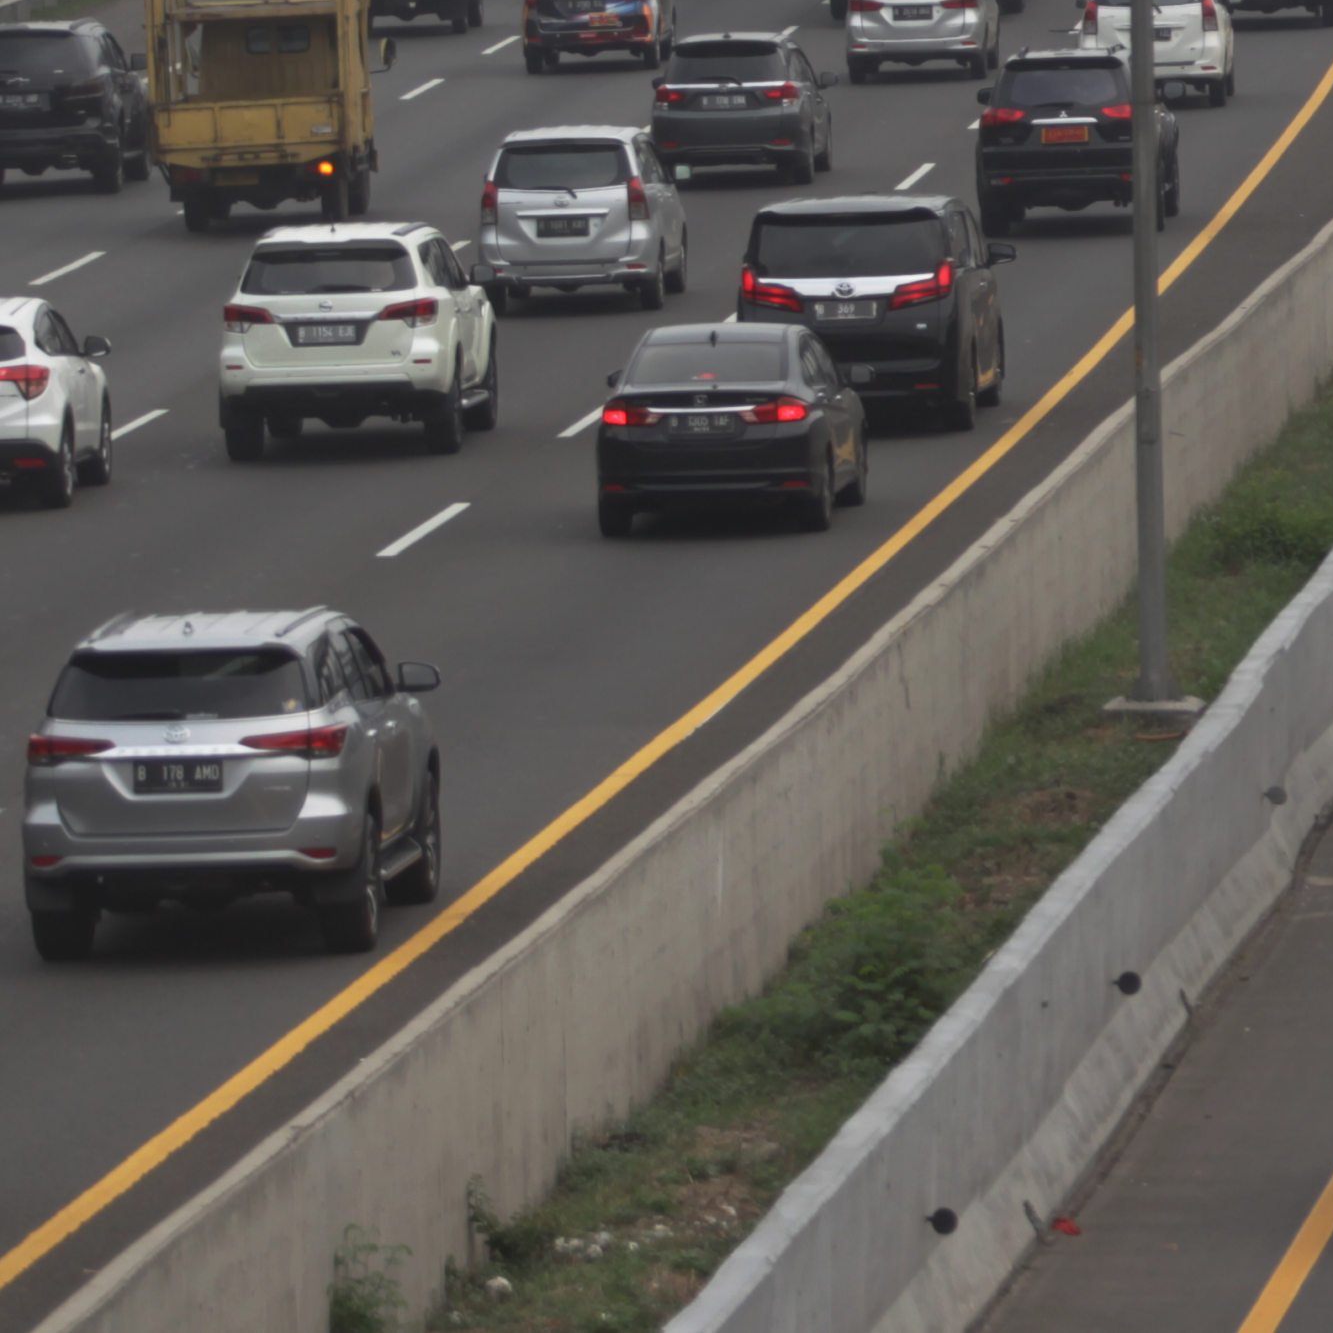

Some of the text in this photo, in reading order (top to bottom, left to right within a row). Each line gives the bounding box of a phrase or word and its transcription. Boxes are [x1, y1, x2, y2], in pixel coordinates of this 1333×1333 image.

[138, 763, 220, 781] B 178 AMD
